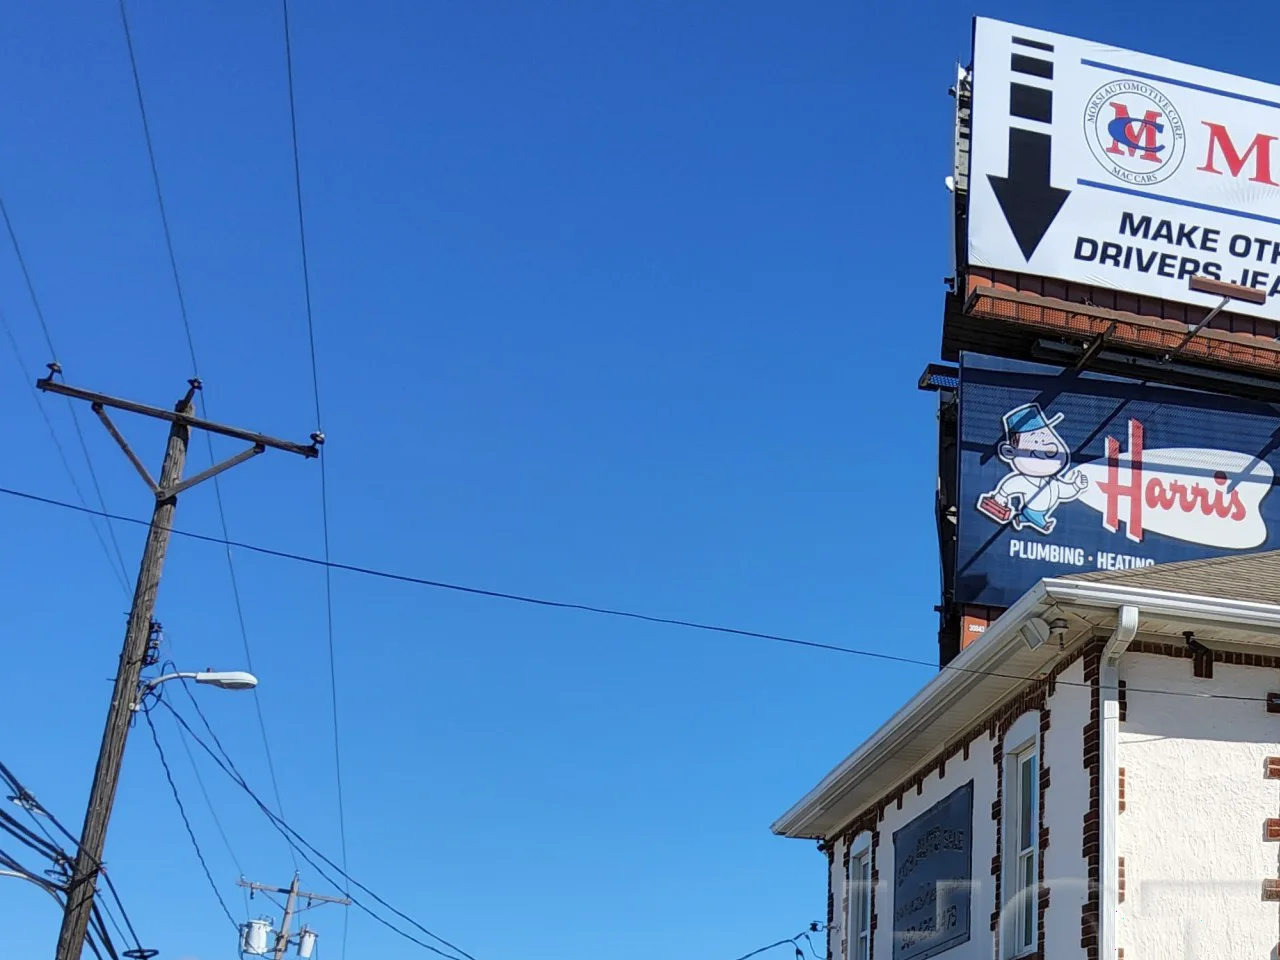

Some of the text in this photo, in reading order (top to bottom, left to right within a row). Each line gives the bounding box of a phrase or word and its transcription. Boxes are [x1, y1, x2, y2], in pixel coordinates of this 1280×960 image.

[1087, 82, 1183, 141] MORSI AUTOMOTIVE CORP.
[1111, 166, 1158, 184] MAC CARS
[1118, 211, 1222, 253] MAKE
[1073, 236, 1223, 282] DRIVERS
[1095, 417, 1247, 543] Harris
[1009, 539, 1085, 566] PLUMBING
